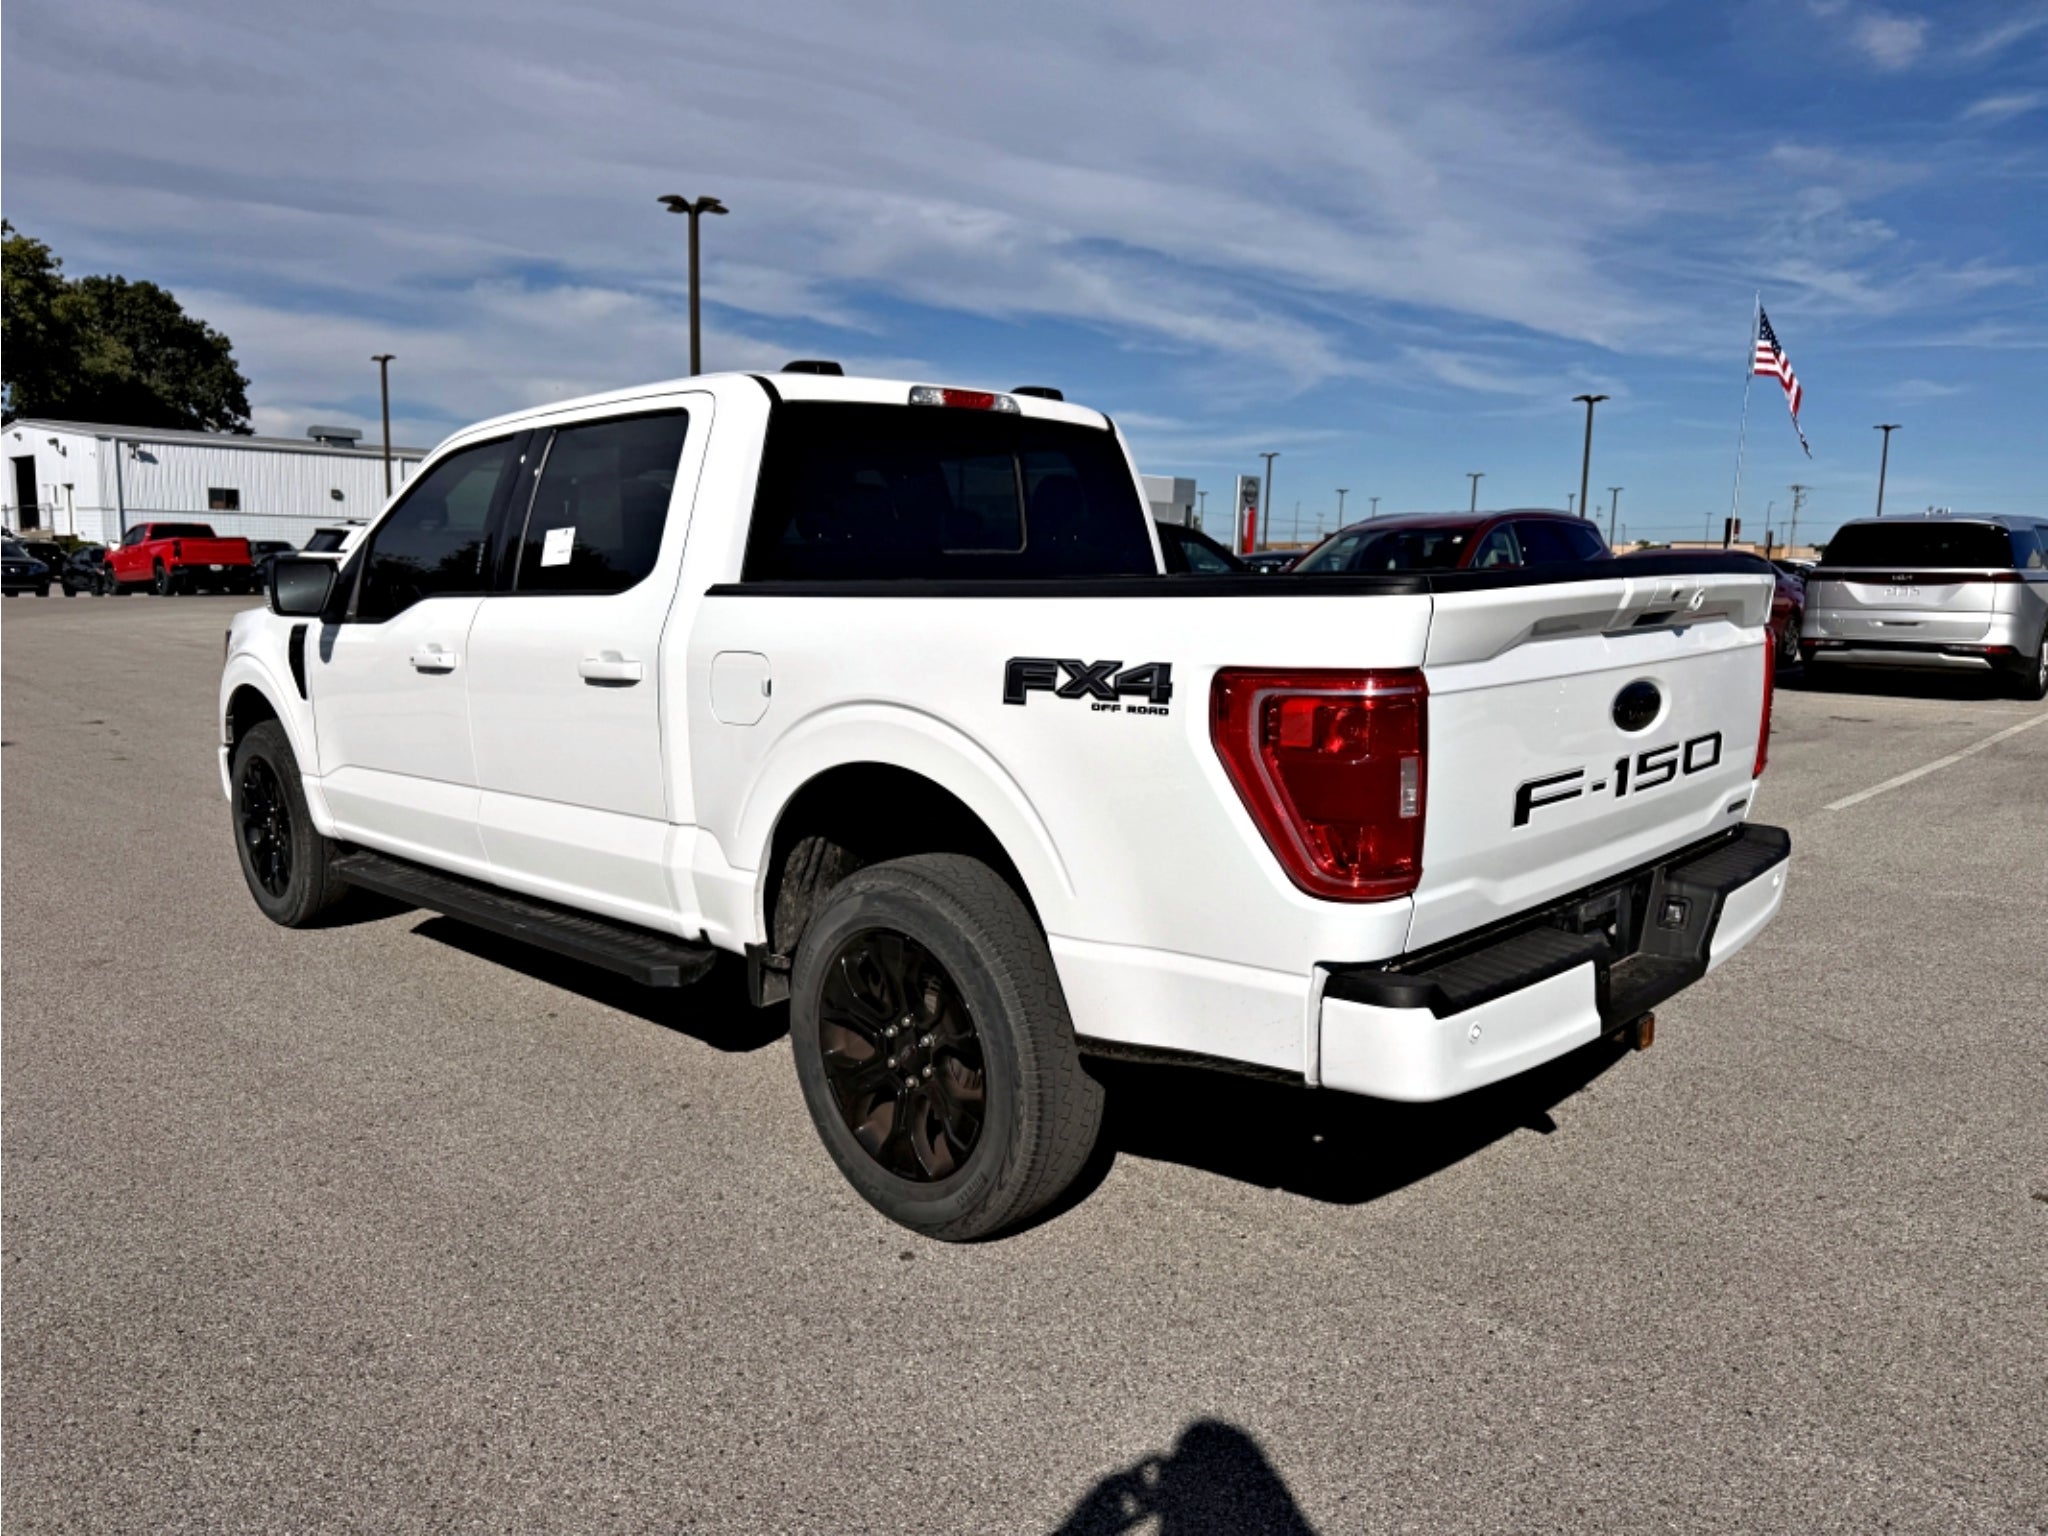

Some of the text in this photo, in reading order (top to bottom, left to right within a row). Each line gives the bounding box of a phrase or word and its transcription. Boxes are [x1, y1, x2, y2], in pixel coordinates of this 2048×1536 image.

[1003, 656, 1173, 705] FX4
[1091, 703, 1169, 715] OFF ROAD
[1511, 730, 1722, 828] F-150
